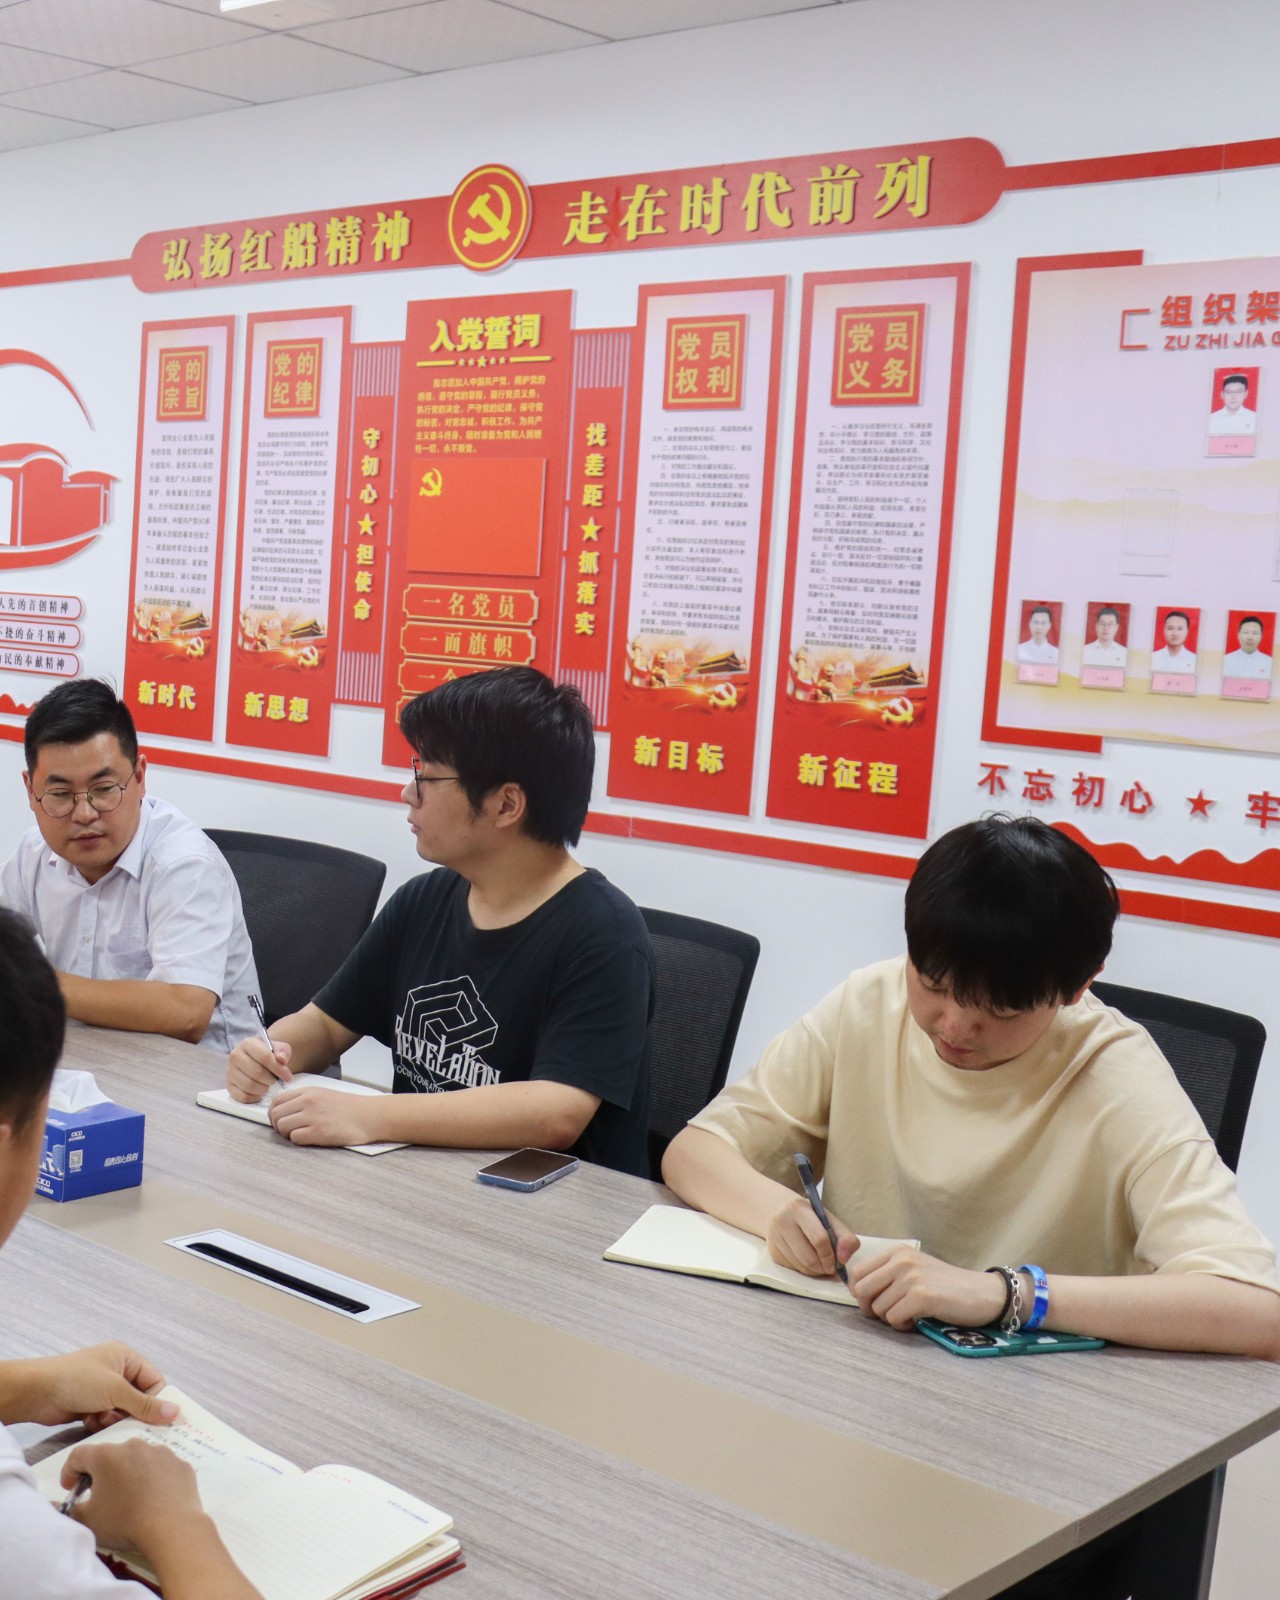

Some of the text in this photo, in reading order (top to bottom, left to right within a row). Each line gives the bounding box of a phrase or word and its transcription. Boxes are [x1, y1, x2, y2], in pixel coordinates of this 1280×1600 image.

[162, 155, 932, 281] 弘扬红船精神 走在时代前列
[1160, 290, 1280, 326] 组织架
[429, 314, 541, 352] 入党誓词
[677, 331, 733, 361] 党员
[847, 321, 910, 353] 党员
[1164, 335, 1190, 350] ZU
[1195, 333, 1228, 349] ZHI
[1233, 331, 1266, 348] JIA
[165, 359, 201, 383] 党的
[274, 352, 314, 377] 党的
[675, 365, 731, 394] 权利
[845, 358, 909, 389] 义务
[164, 386, 200, 409] 宗旨
[273, 380, 314, 405] 纪律
[423, 592, 515, 619] 一名党员
[420, 632, 513, 658] 一面旗帜
[138, 680, 196, 711] 新时代
[244, 692, 309, 723] 新思想
[633, 735, 725, 774] 新目标
[797, 753, 898, 795] 新征程
[978, 762, 1155, 815] 不忘初心
